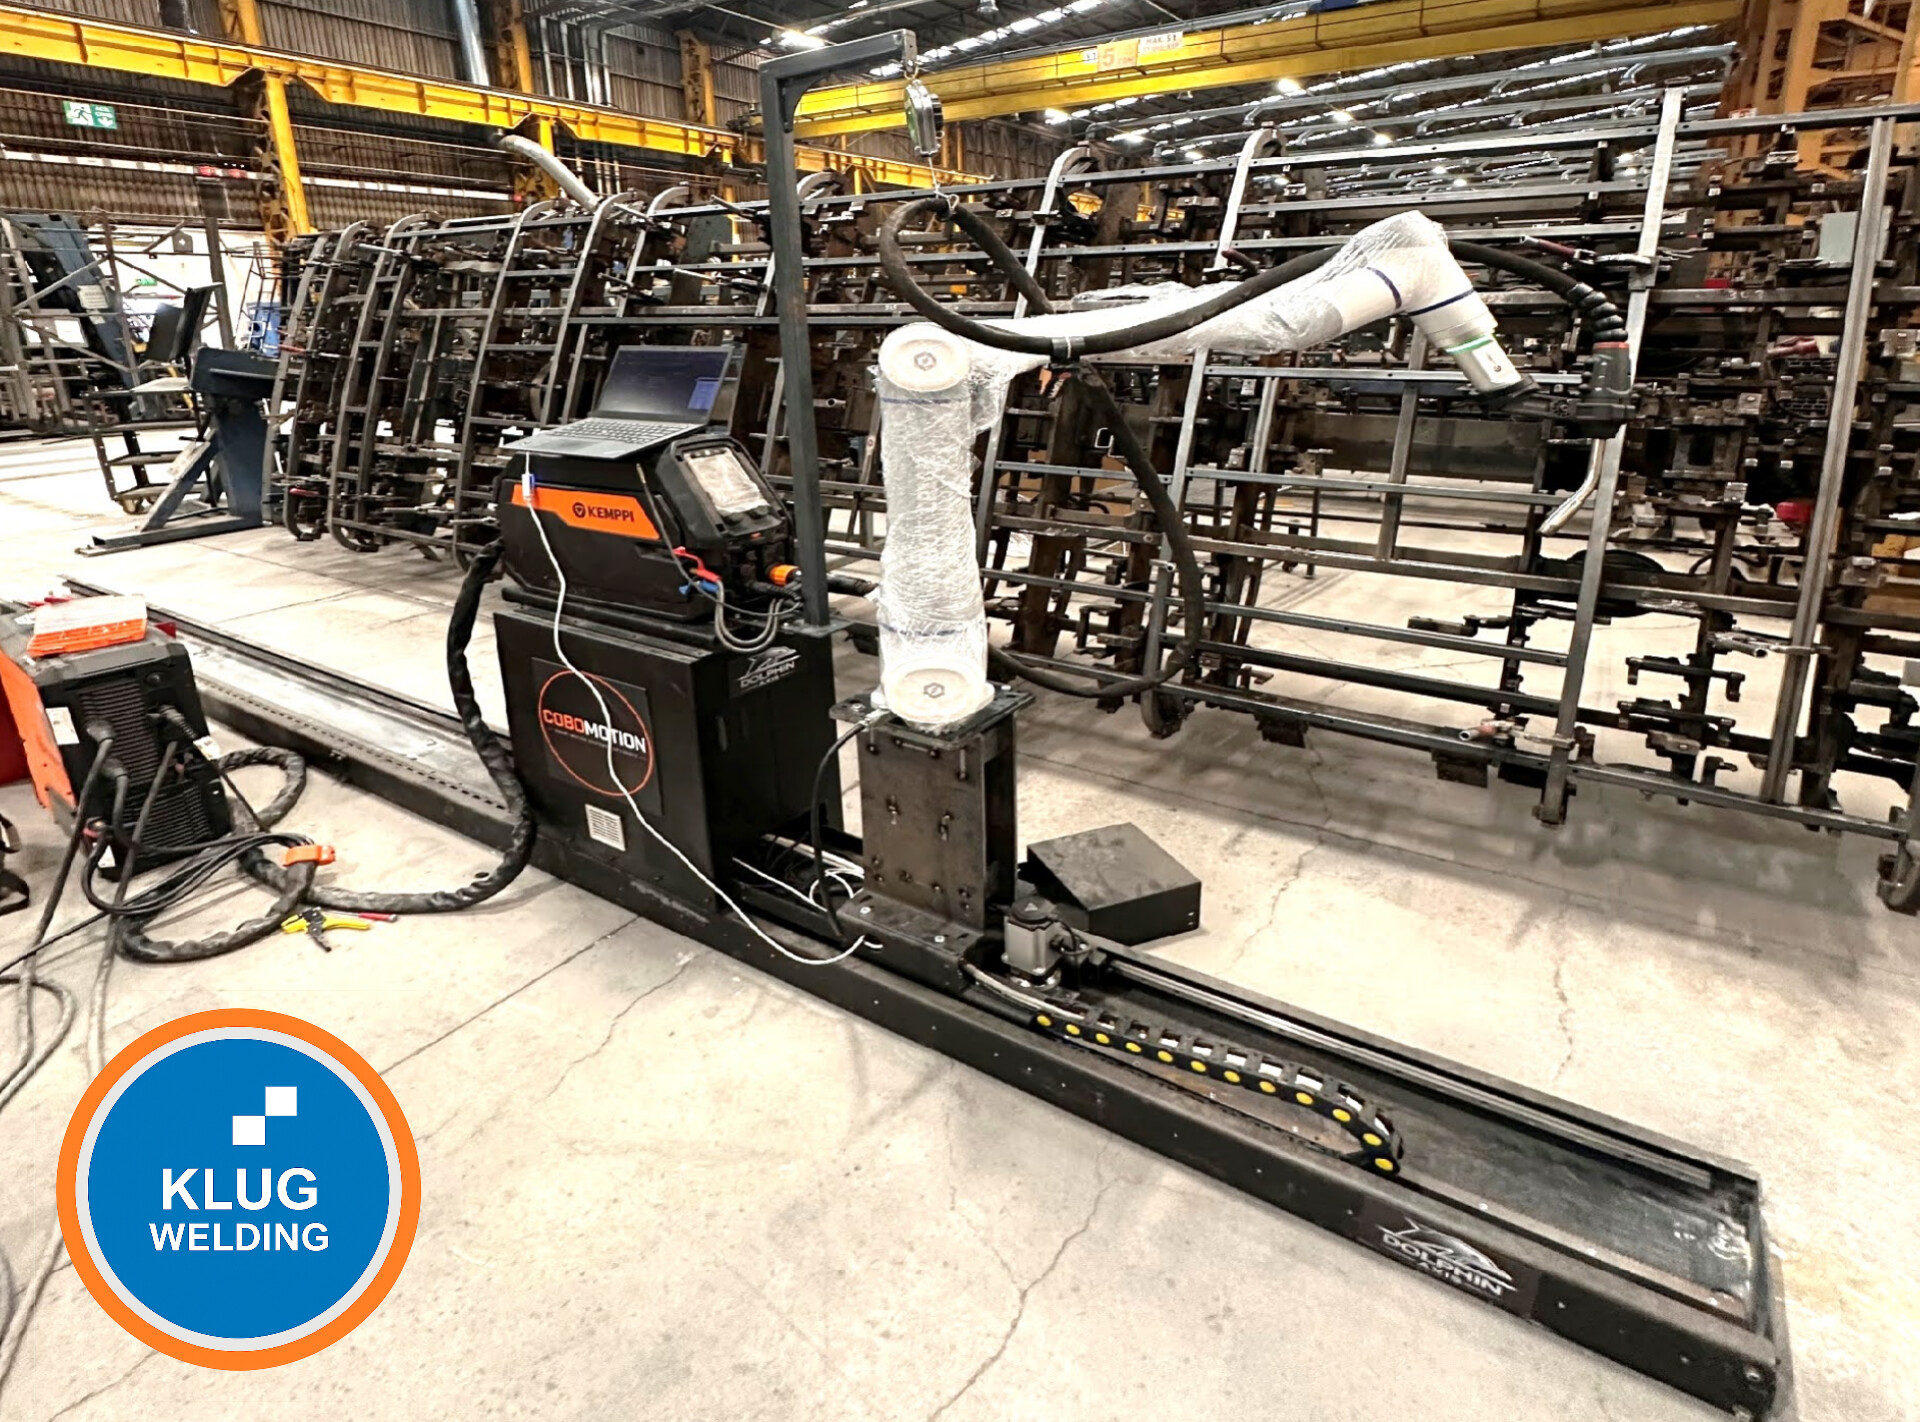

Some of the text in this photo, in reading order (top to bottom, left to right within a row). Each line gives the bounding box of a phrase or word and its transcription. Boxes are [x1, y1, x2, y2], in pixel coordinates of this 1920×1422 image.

[587, 505, 635, 523] KEMPPI
[740, 660, 796, 688] DOLPHIN
[542, 709, 647, 754] COBOMOTION
[1382, 1232, 1503, 1297] DOLPHIN
